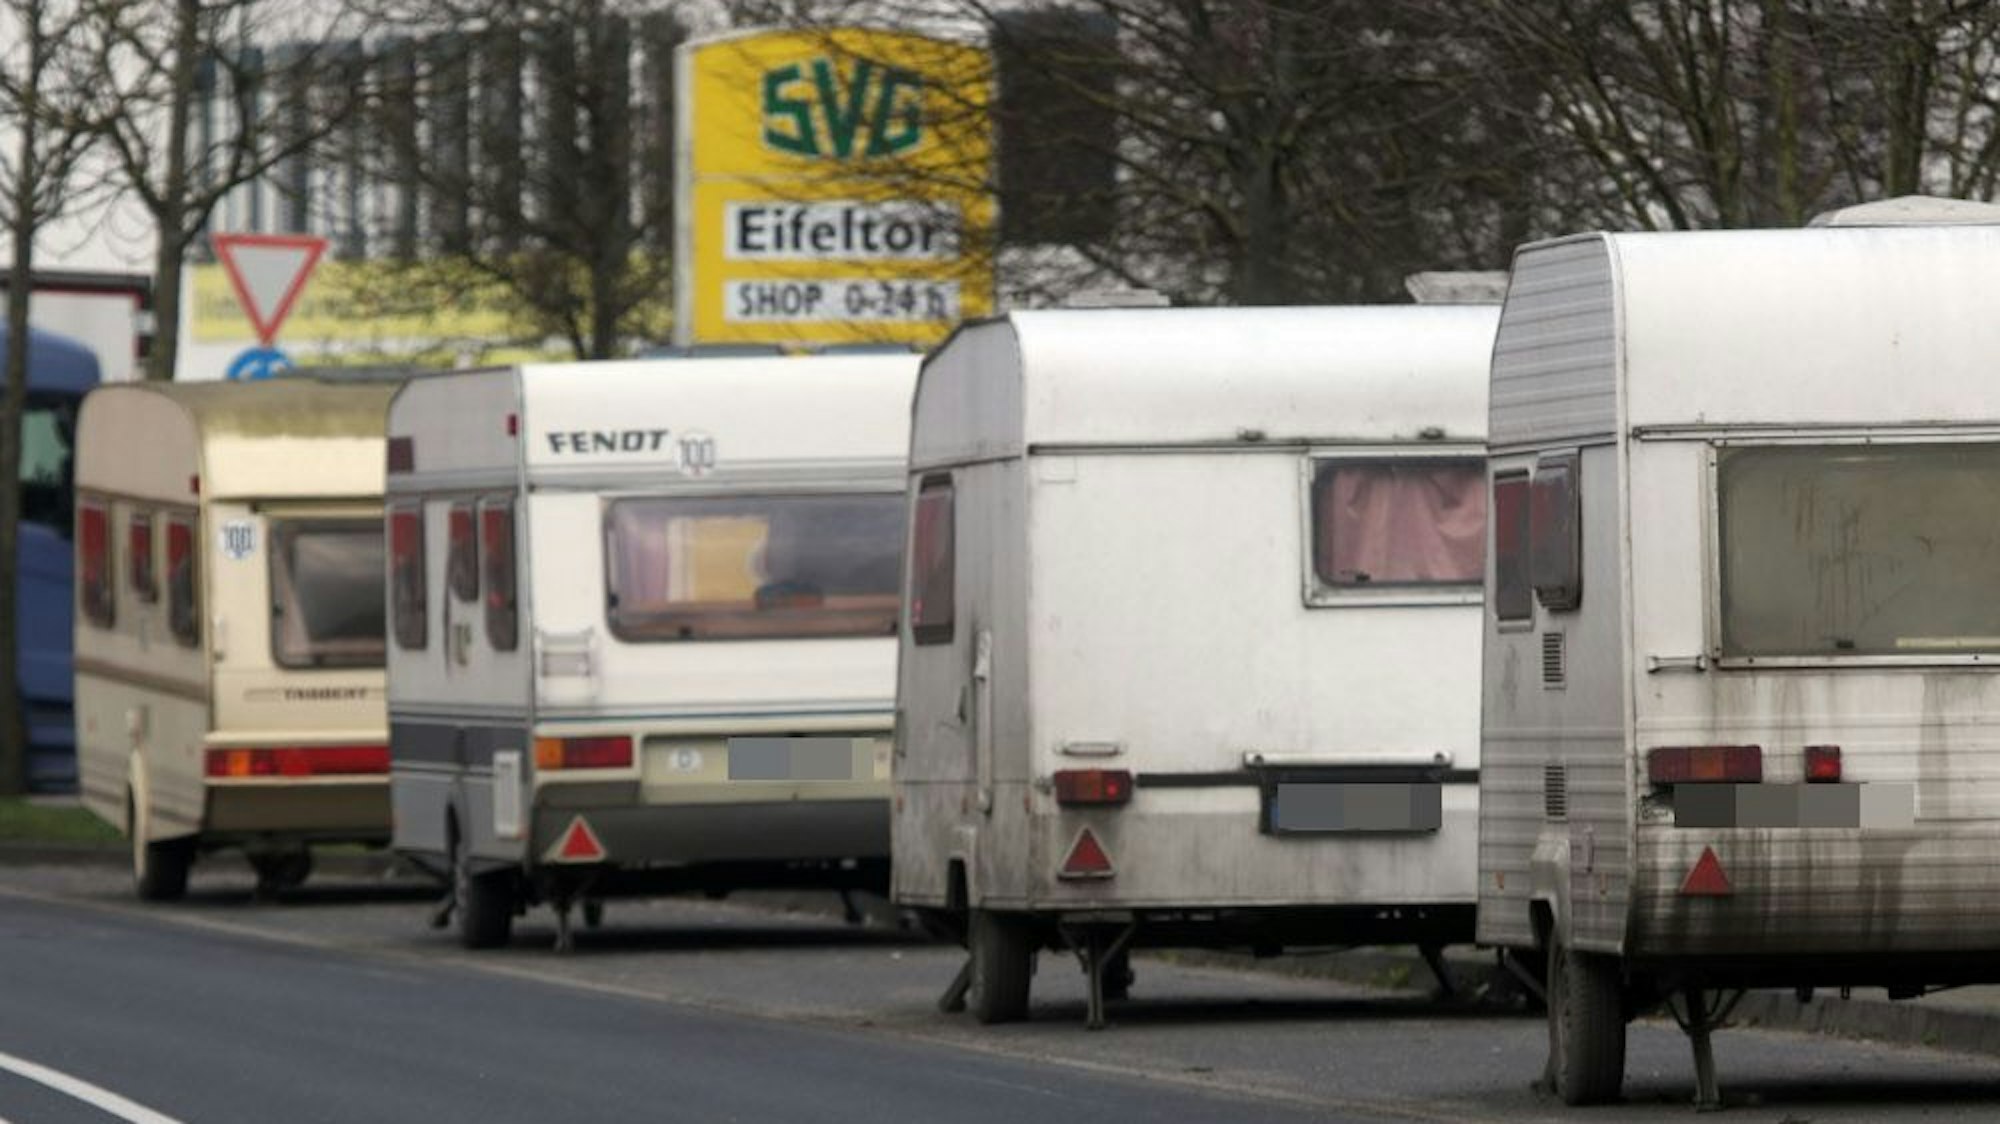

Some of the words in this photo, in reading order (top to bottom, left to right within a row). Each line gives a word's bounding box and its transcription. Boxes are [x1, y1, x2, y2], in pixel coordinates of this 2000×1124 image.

[762, 58, 921, 158] SVG
[738, 207, 937, 252] Eifeltor
[739, 284, 822, 317] SHOP
[846, 284, 916, 317] 0-24
[547, 430, 668, 453] FENDT
